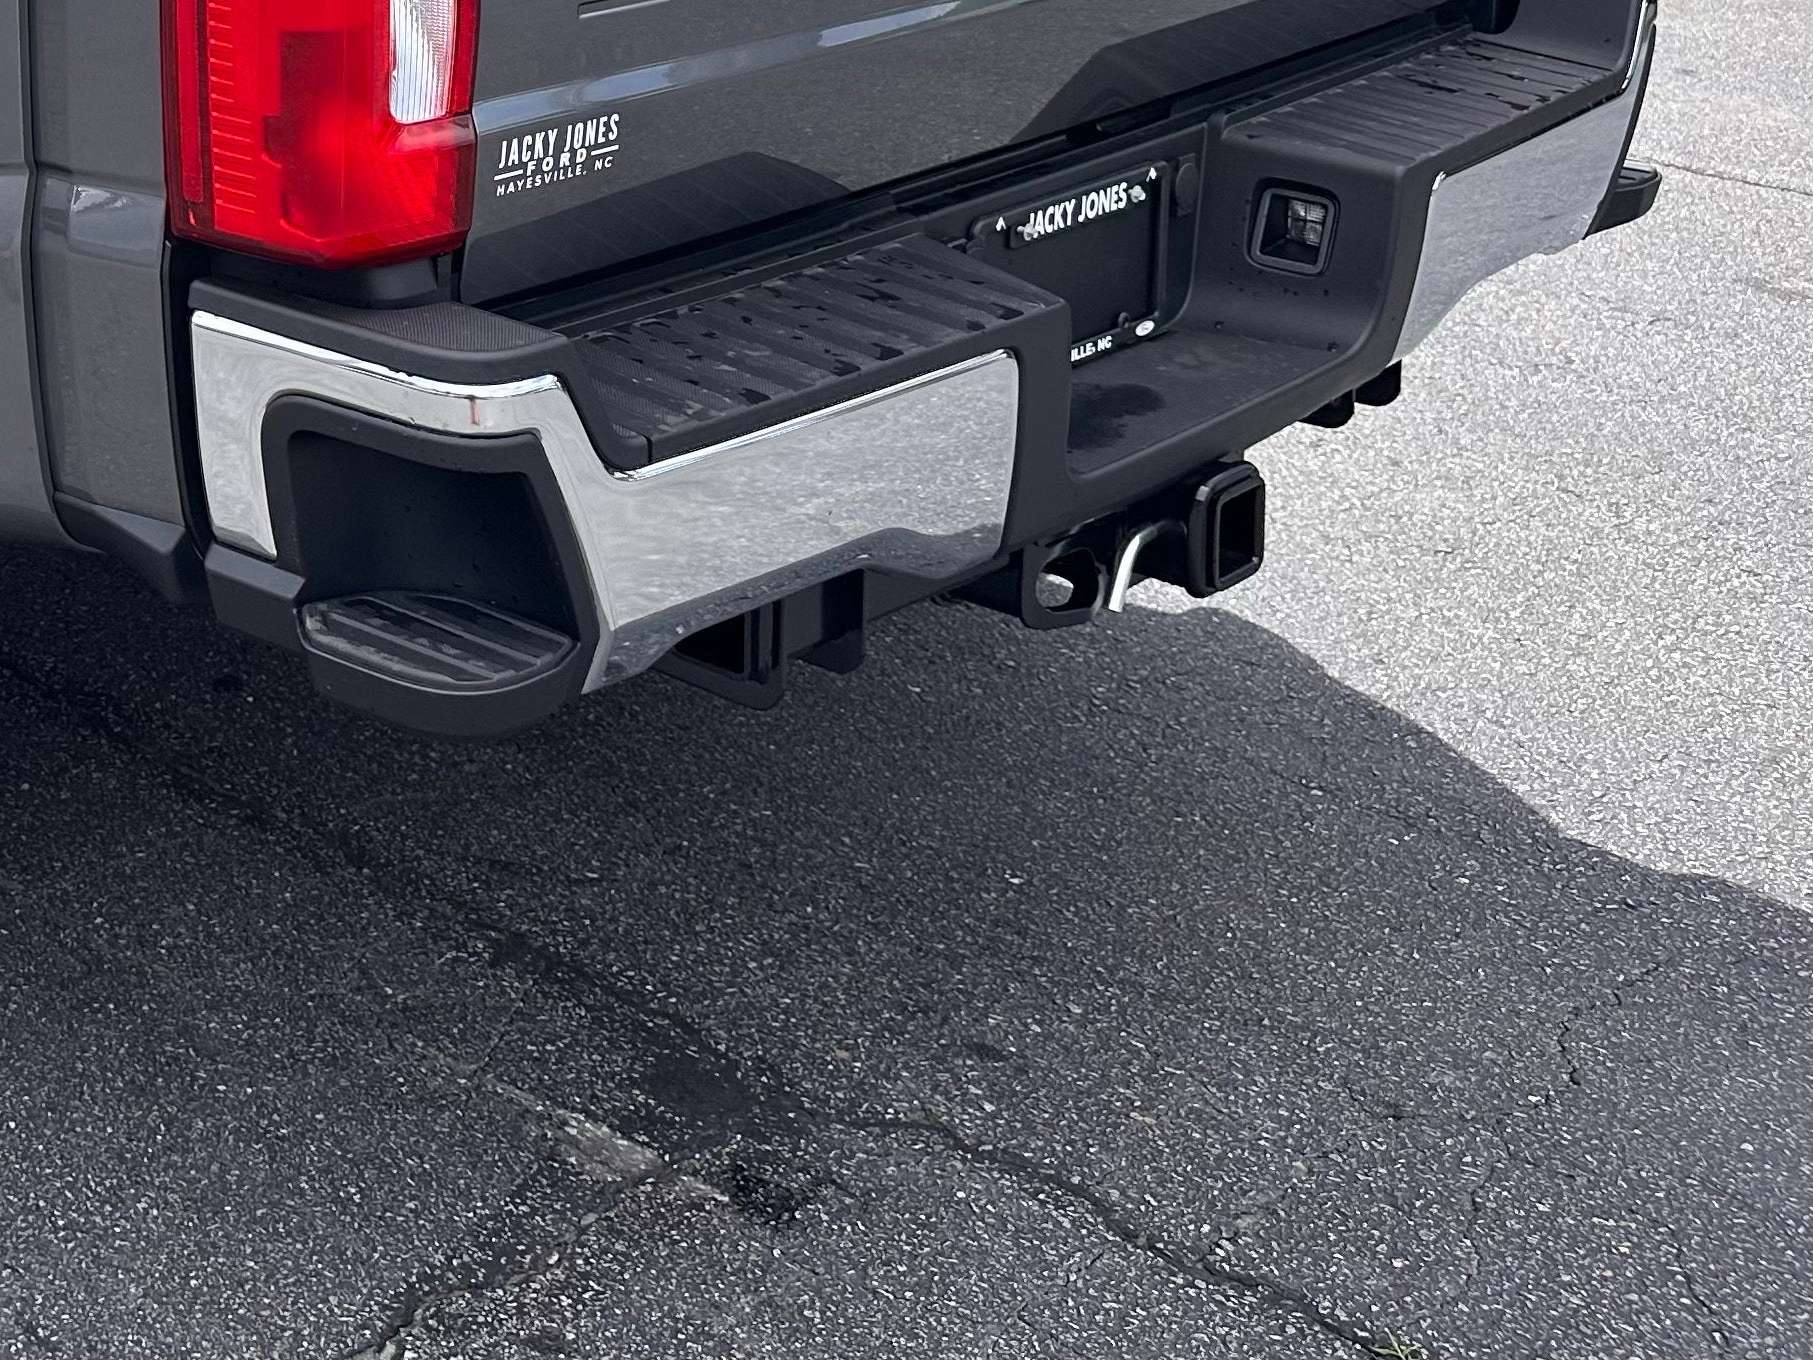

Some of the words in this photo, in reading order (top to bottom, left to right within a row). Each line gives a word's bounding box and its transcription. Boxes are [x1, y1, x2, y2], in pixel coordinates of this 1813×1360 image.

[498, 128, 559, 169] JACKY
[563, 113, 620, 153] JONES
[526, 147, 587, 177] FORD
[594, 156, 614, 172] NC
[1077, 181, 1128, 223] JONES
[1097, 335, 1112, 352] NC
